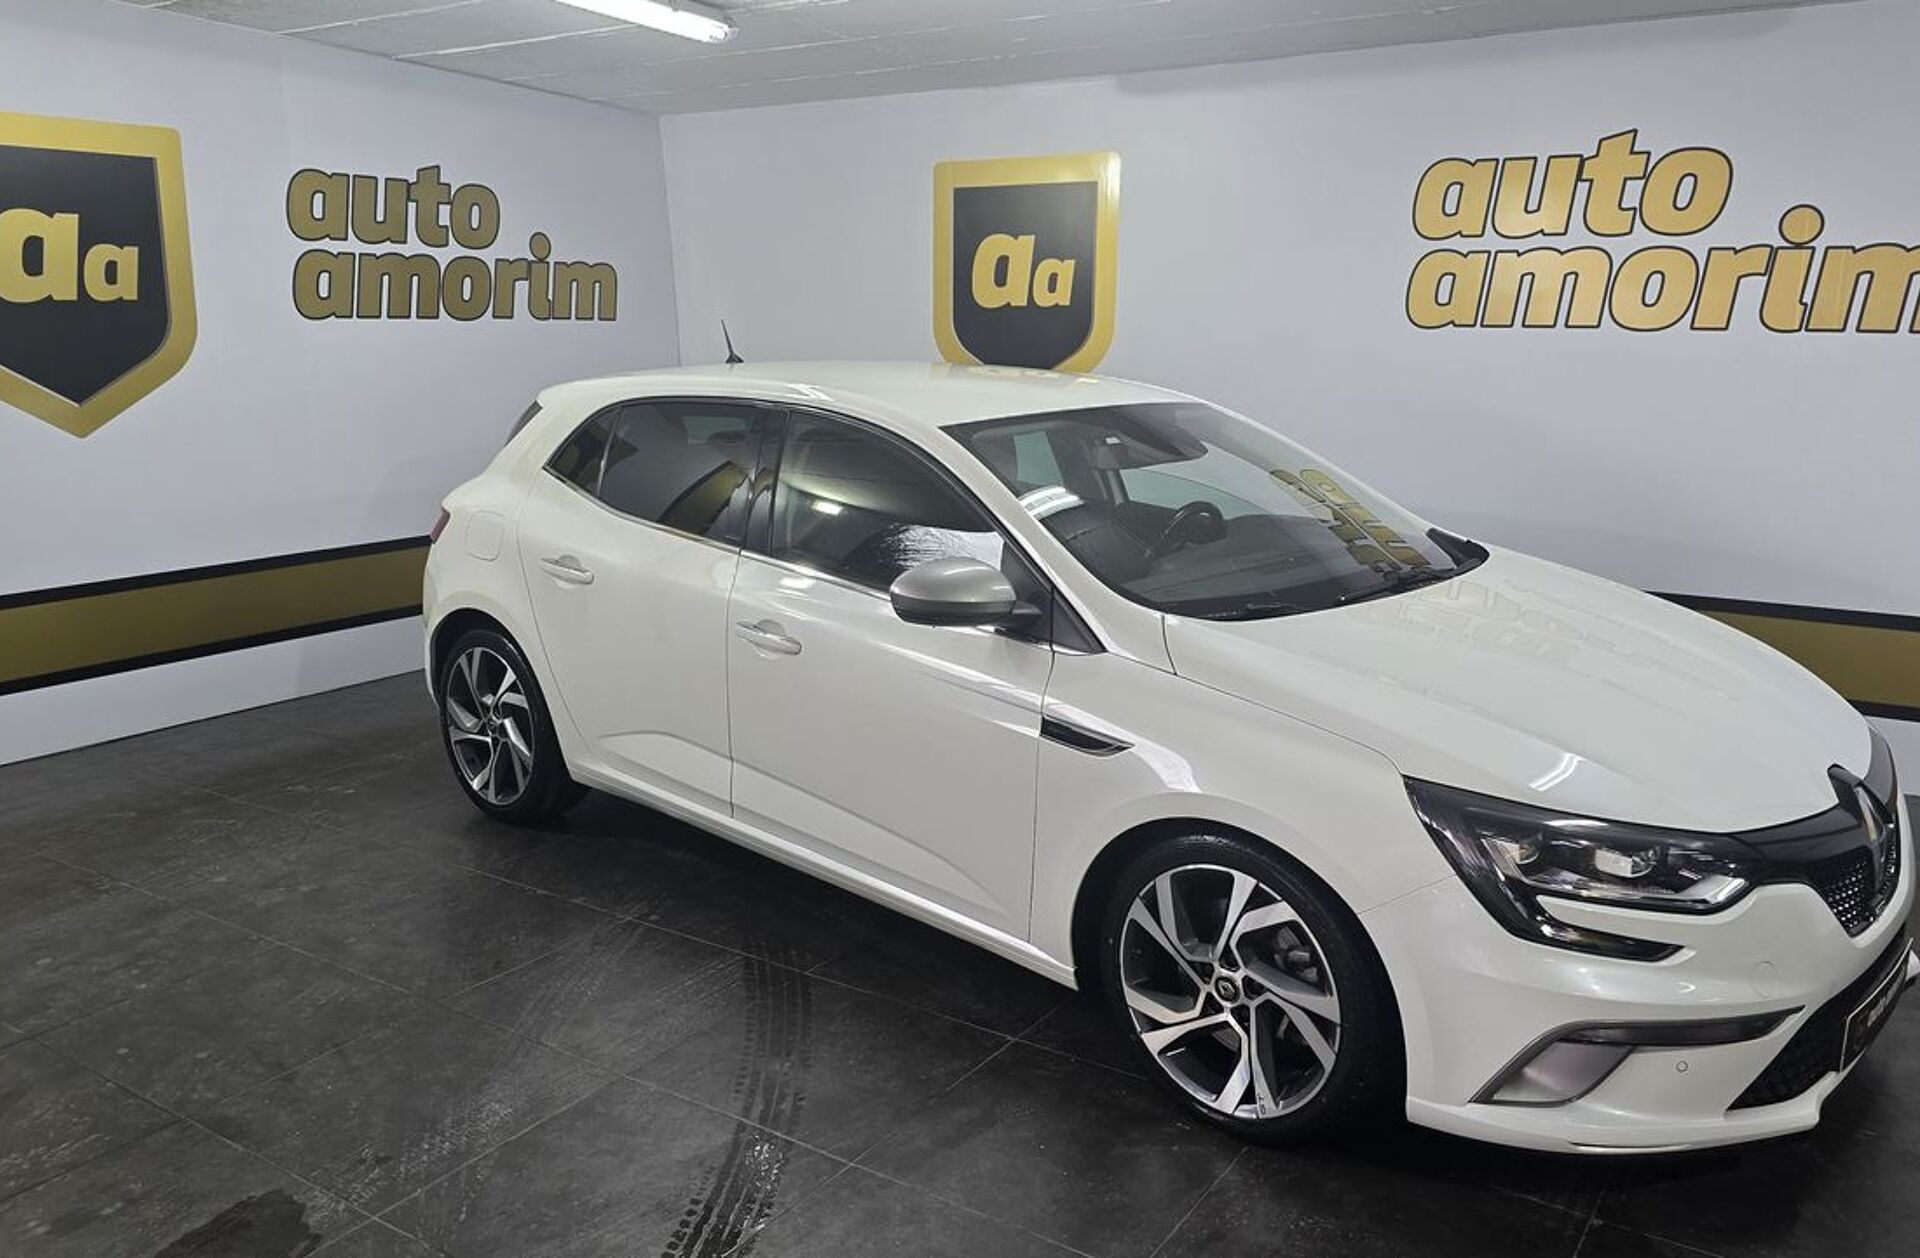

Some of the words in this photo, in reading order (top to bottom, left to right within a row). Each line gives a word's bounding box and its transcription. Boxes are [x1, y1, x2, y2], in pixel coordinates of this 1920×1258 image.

[286, 164, 500, 250] auto
[1412, 128, 1734, 239] auto
[292, 231, 618, 321] amorim
[971, 233, 1075, 309] aa
[1405, 204, 1920, 334] amorim
